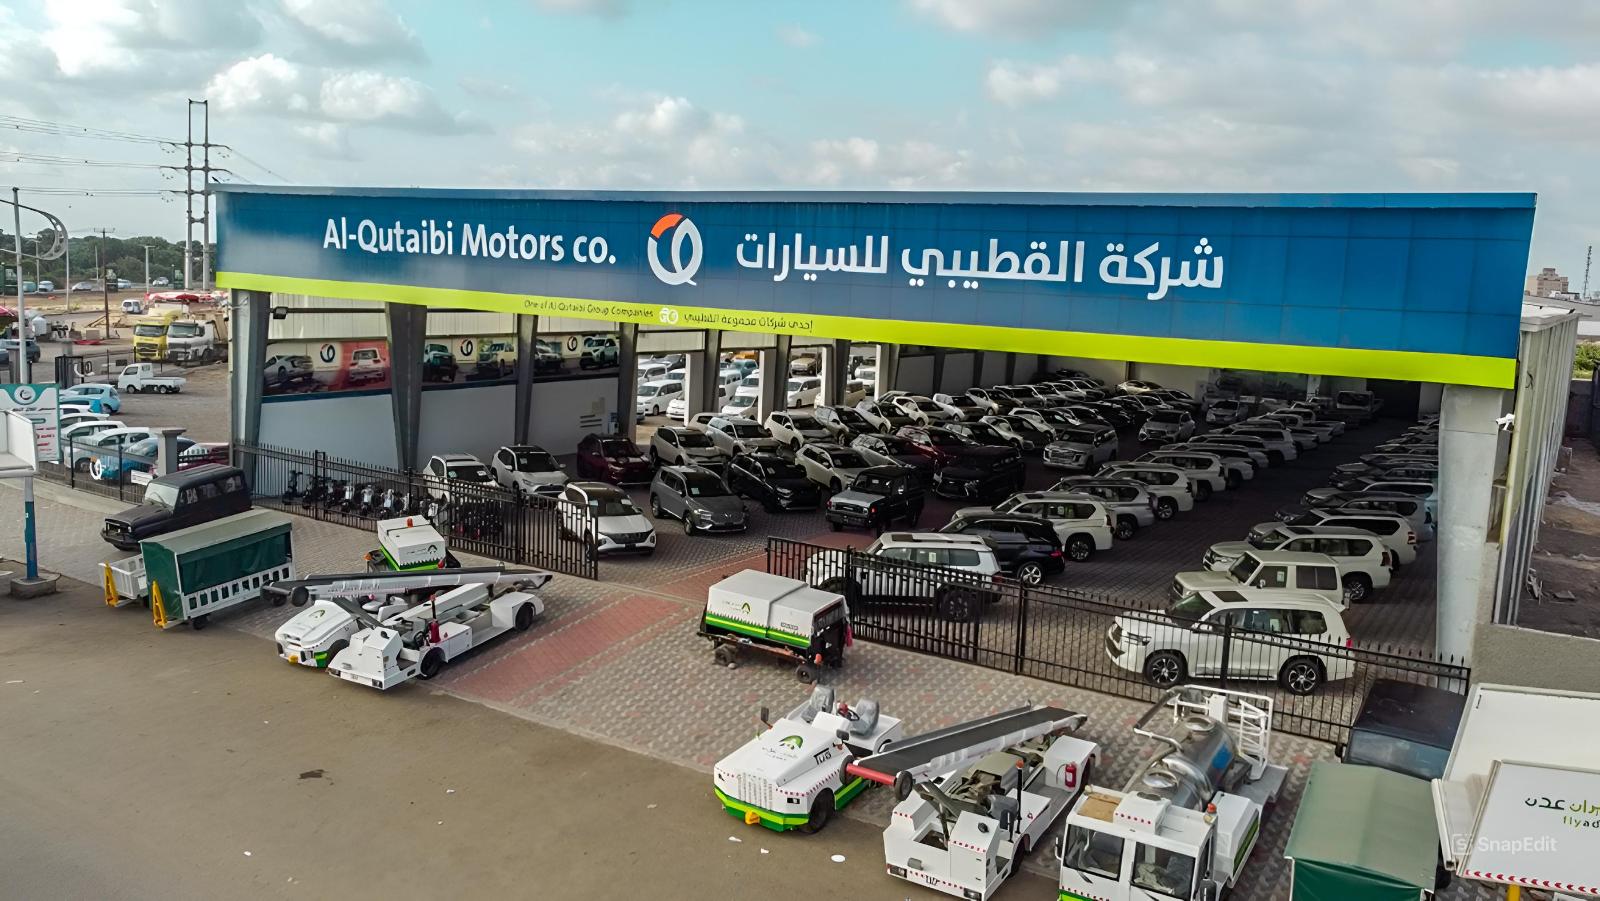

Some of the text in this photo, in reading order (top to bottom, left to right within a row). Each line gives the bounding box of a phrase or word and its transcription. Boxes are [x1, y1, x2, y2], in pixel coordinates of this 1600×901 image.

[323, 217, 617, 264] Al-Qutaibi Motors co.
[736, 232, 1223, 301] شركة القطيبي للسيارات
[587, 304, 608, 316] Group
[612, 306, 654, 318] Companies
[721, 314, 756, 327] مجموعة
[759, 315, 787, 330] شركات
[1525, 797, 1566, 811] عدن
